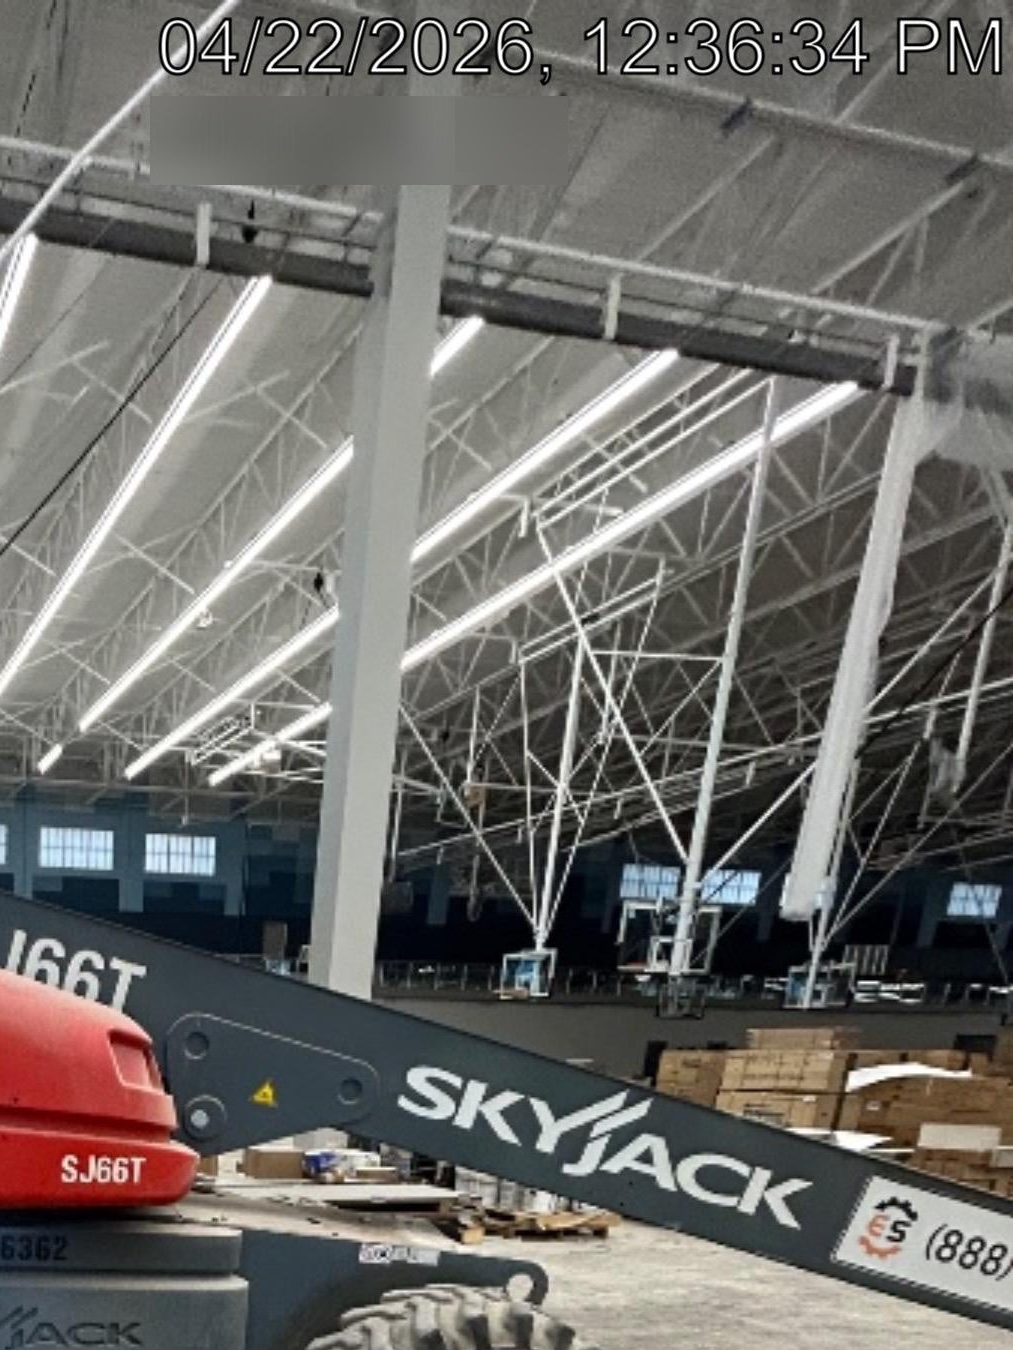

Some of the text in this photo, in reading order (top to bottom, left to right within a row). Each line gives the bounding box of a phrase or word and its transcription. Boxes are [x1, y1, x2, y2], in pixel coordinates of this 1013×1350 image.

[397, 1065, 814, 1231] SKYJACK
[60, 1154, 147, 1184] SJ66T
[0, 1234, 69, 1262] 6362
